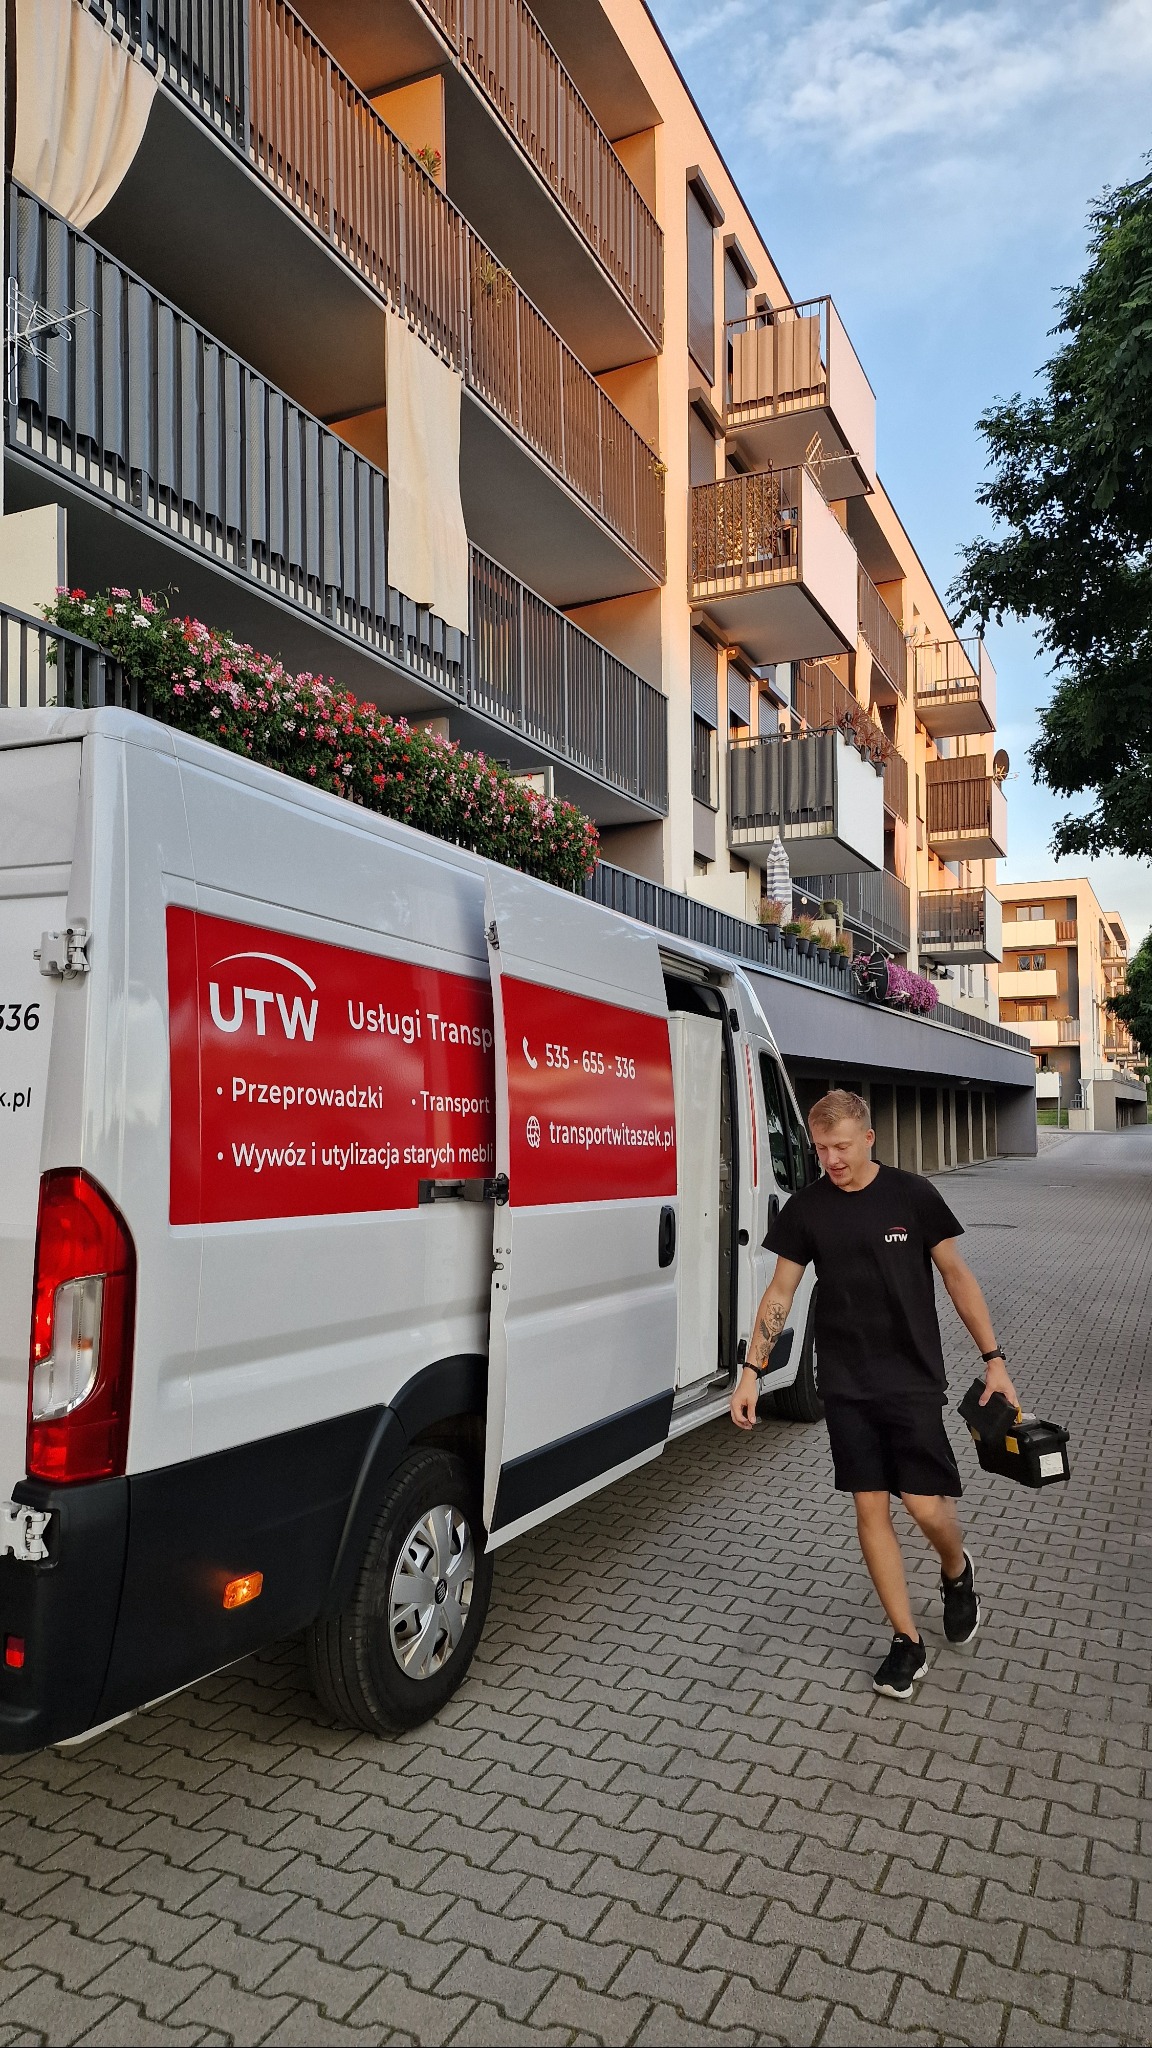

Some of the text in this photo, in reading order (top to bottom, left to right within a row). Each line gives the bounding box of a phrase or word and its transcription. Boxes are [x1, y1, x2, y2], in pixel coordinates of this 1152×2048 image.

[209, 982, 318, 1041] UTW
[348, 1000, 496, 1053] Usługi Transp
[232, 1077, 383, 1109] Przeprowadzki
[420, 1091, 490, 1117] Transport
[550, 1122, 674, 1151] transportwitaszek.pl
[232, 1142, 493, 1172] Wywóz i utylizacja starych mebli
[884, 1233, 908, 1243] UTW
